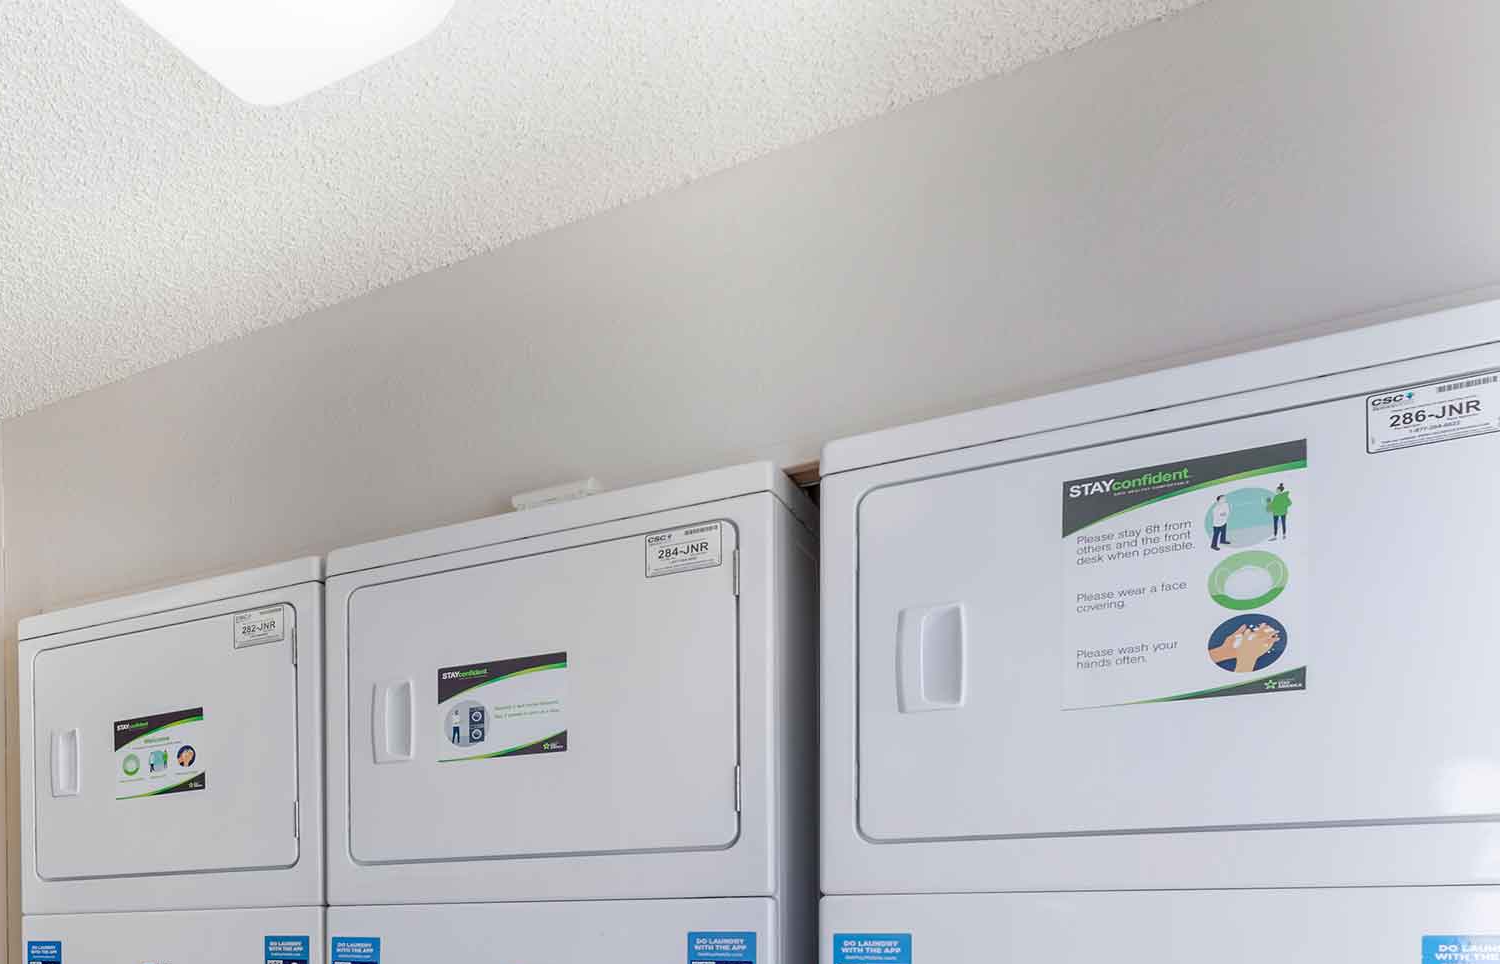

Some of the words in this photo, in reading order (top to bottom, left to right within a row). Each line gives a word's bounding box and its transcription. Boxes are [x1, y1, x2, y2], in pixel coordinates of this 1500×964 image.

[1371, 394, 1404, 406] CSC
[1389, 400, 1483, 428] 286-JNR
[1069, 466, 1189, 498] STAYconfident
[1076, 543, 1112, 555] others
[1116, 537, 1138, 550] and
[1142, 534, 1160, 545] the
[1164, 530, 1191, 542] front
[1077, 533, 1115, 545] Please
[1118, 528, 1141, 539] stay
[1145, 524, 1160, 535] 6ft
[1164, 520, 1192, 531] from
[658, 541, 709, 559] 284-JNR
[1077, 553, 1105, 566] desk
[1107, 549, 1139, 561] when
[1143, 542, 1196, 557] possible.
[1076, 591, 1115, 603] Please
[1117, 587, 1146, 598] wear
[1150, 585, 1157, 593] a
[1161, 582, 1187, 592] face
[242, 620, 276, 634] 282-JNR
[1076, 648, 1114, 659] Please
[1117, 643, 1149, 655] wash
[1152, 640, 1178, 652] your
[1076, 658, 1112, 670] hands
[1115, 655, 1147, 665] often.
[1438, 944, 1458, 952] DO
[1461, 944, 1500, 952] LAUN
